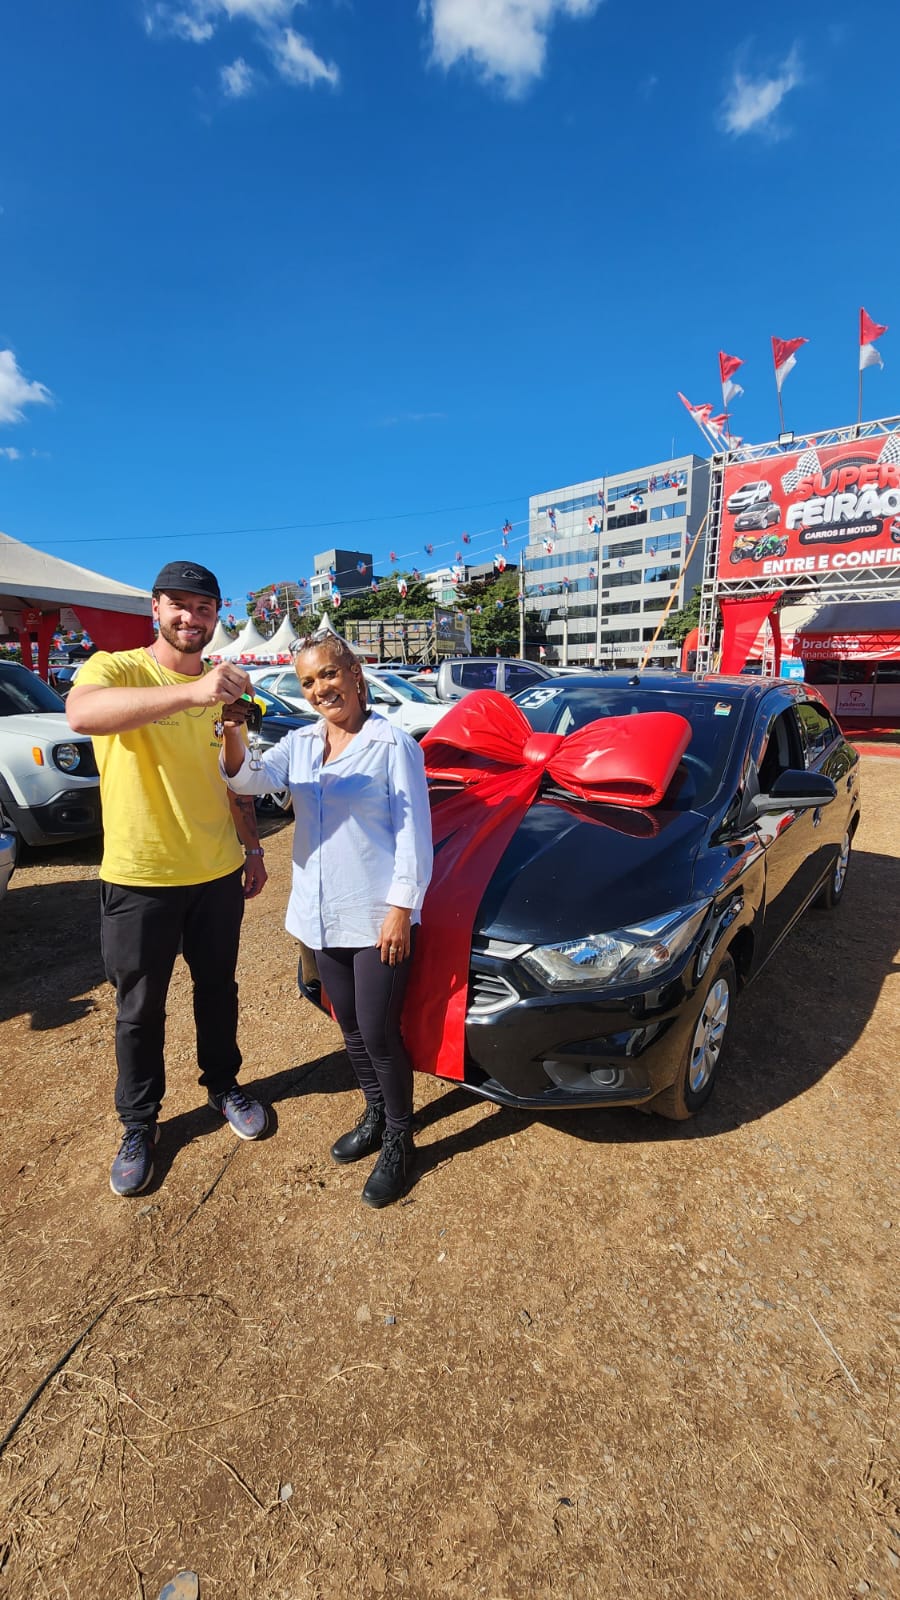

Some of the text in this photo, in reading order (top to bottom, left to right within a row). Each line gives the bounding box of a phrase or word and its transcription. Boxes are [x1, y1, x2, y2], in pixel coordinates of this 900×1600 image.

[794, 463, 900, 500] SUPER
[786, 483, 900, 530] FEIRÃO
[805, 530, 838, 540] CARROS
[847, 525, 877, 535] MOTOS
[763, 557, 815, 574] ENTRE
[818, 555, 829, 569] E
[803, 638, 859, 649] bradesco
